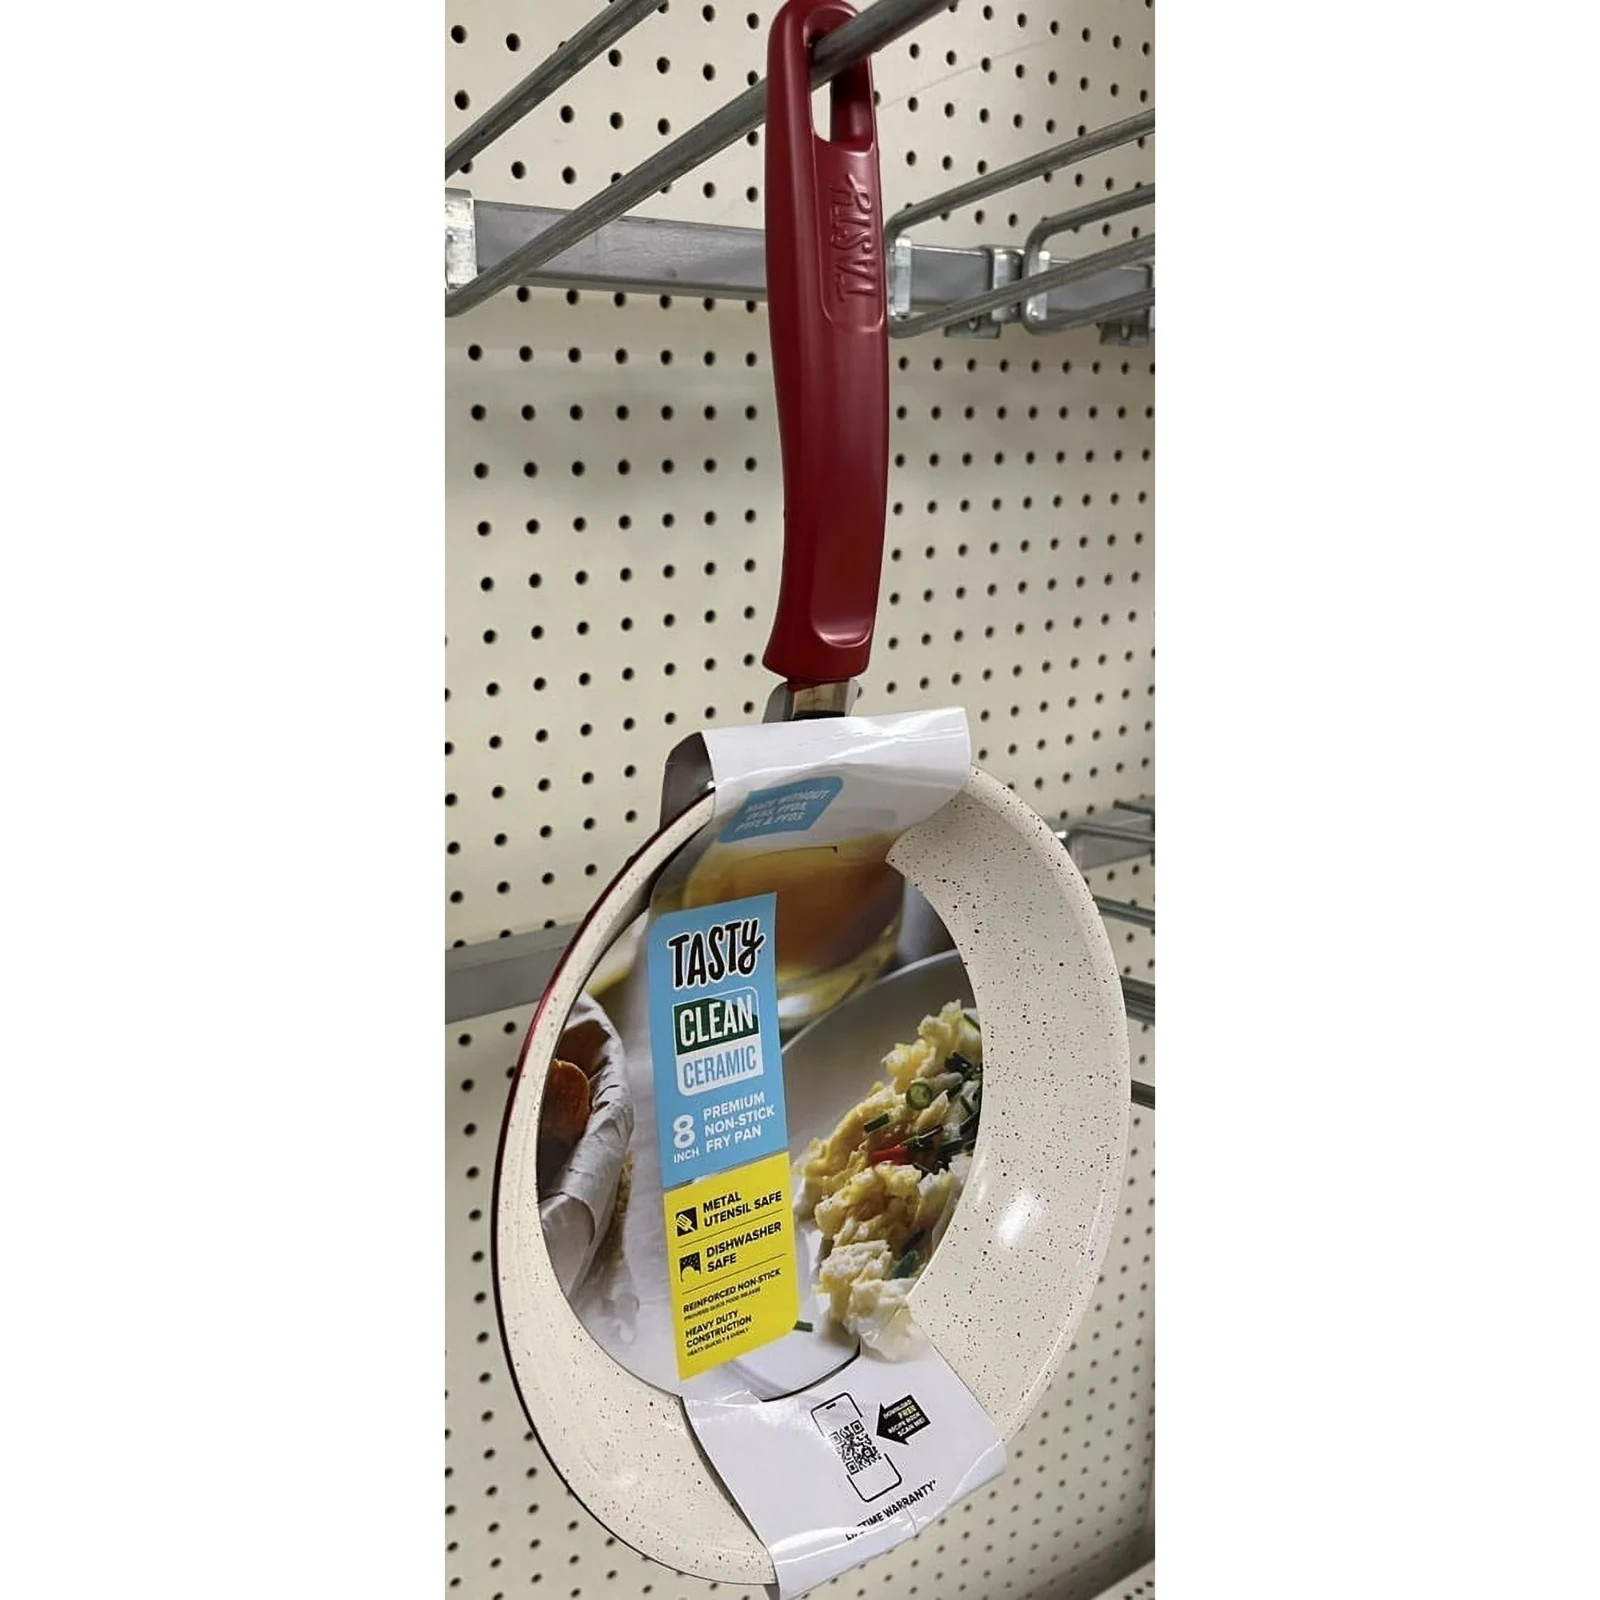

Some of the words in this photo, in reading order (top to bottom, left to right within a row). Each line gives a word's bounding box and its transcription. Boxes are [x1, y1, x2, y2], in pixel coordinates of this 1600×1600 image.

[667, 918, 765, 989] TASTY
[679, 994, 754, 1047] CLEAN
[683, 1044, 757, 1089] CERAMIC
[703, 1091, 765, 1121] PREMIUM
[704, 1103, 776, 1138] NON-STICK
[672, 1113, 696, 1149] 8
[706, 1133, 731, 1153] FRY
[733, 1124, 762, 1146] PAN
[673, 1148, 699, 1164] INCH
[702, 1191, 742, 1213] METAL
[703, 1205, 752, 1228] UTENSIL
[753, 1190, 783, 1211] SAFE
[706, 1221, 782, 1258] DISHWASHER
[707, 1252, 737, 1273] SAFE
[683, 1285, 737, 1313] REINFORCED
[737, 1268, 781, 1292] NON-STICK
[685, 1319, 714, 1338] HEAVY
[715, 1309, 739, 1325] DUTY
[686, 1314, 752, 1348] CONSTRUCTION
[845, 1512, 884, 1541] LTIME
